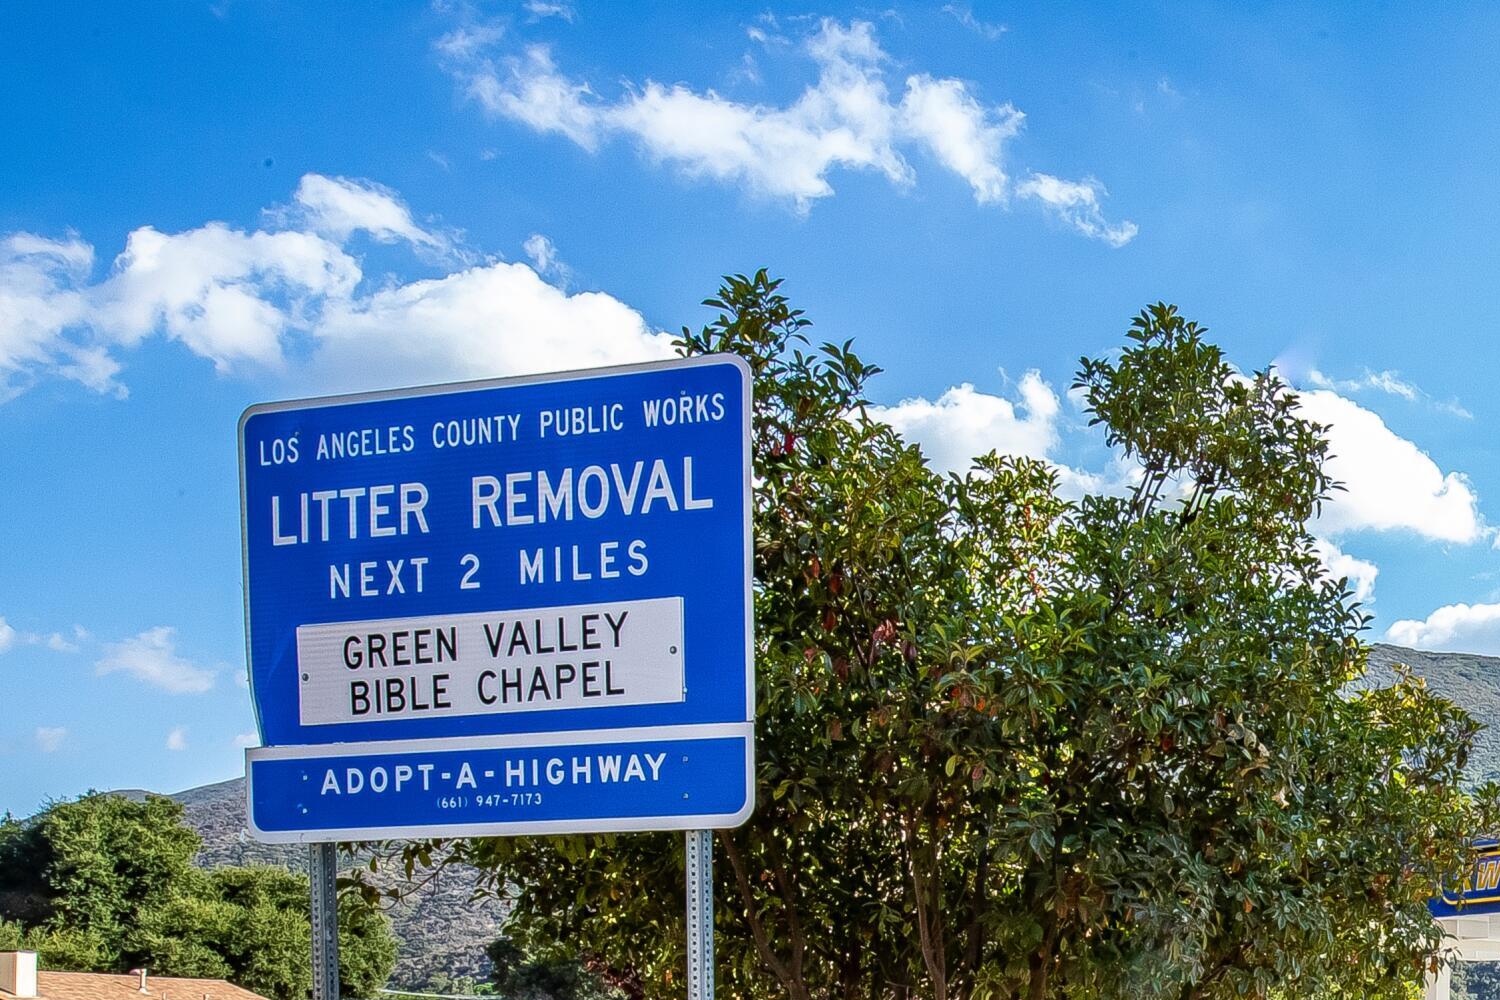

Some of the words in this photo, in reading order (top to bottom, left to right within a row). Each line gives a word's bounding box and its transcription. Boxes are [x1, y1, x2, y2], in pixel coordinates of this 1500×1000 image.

[260, 437, 300, 466] LOS
[316, 425, 415, 460] ANGELES
[432, 414, 522, 449] COUNTY
[540, 403, 624, 438] PUBLIC
[643, 393, 726, 427] WORKS
[272, 482, 430, 546] LITTER
[472, 456, 714, 529] REMOVAL
[330, 557, 429, 599] NEXT
[460, 553, 481, 590] 2
[519, 539, 649, 585] MILES
[343, 626, 458, 670] GREEN
[483, 611, 629, 658] VALLEY
[350, 673, 452, 716] BIBLE
[477, 660, 625, 705] CHAPEL
[320, 753, 667, 796] ADOPT-A-HIGHWAY
[436, 796, 468, 809] (661)
[476, 792, 542, 807] 947-7173
